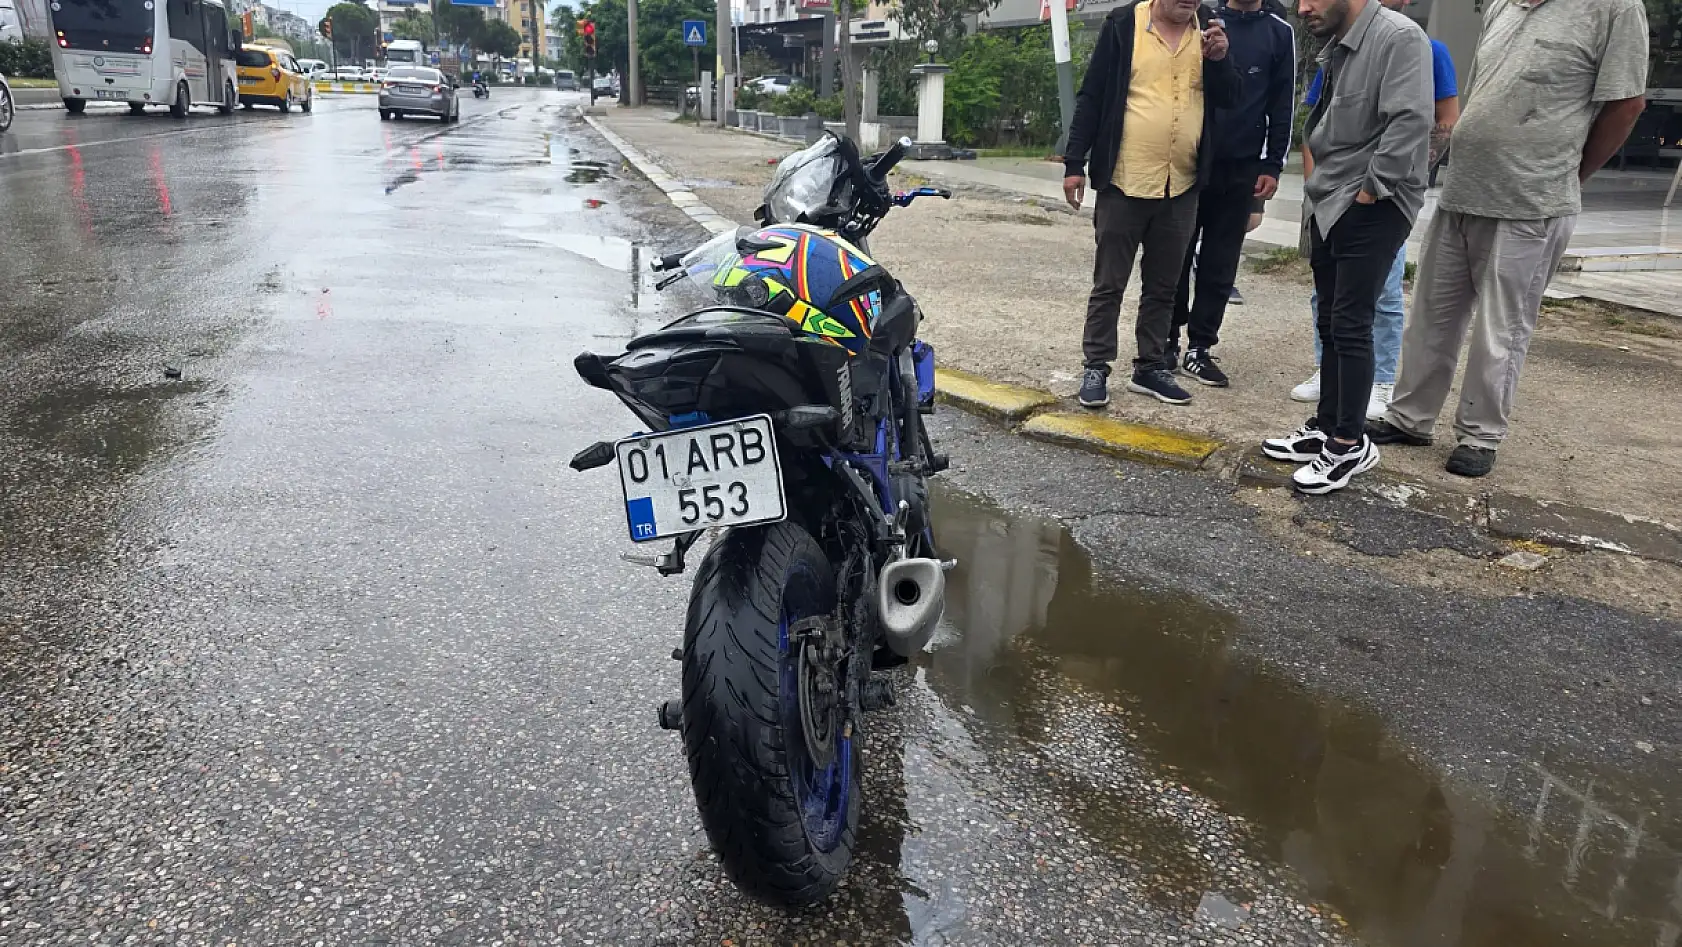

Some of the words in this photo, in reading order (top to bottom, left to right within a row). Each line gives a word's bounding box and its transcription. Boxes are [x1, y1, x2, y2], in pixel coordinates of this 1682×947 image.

[837, 361, 852, 430] YAMAHA
[628, 444, 668, 483] 01
[688, 427, 766, 475] ARB
[678, 481, 750, 524] 553
[636, 523, 653, 536] TR
